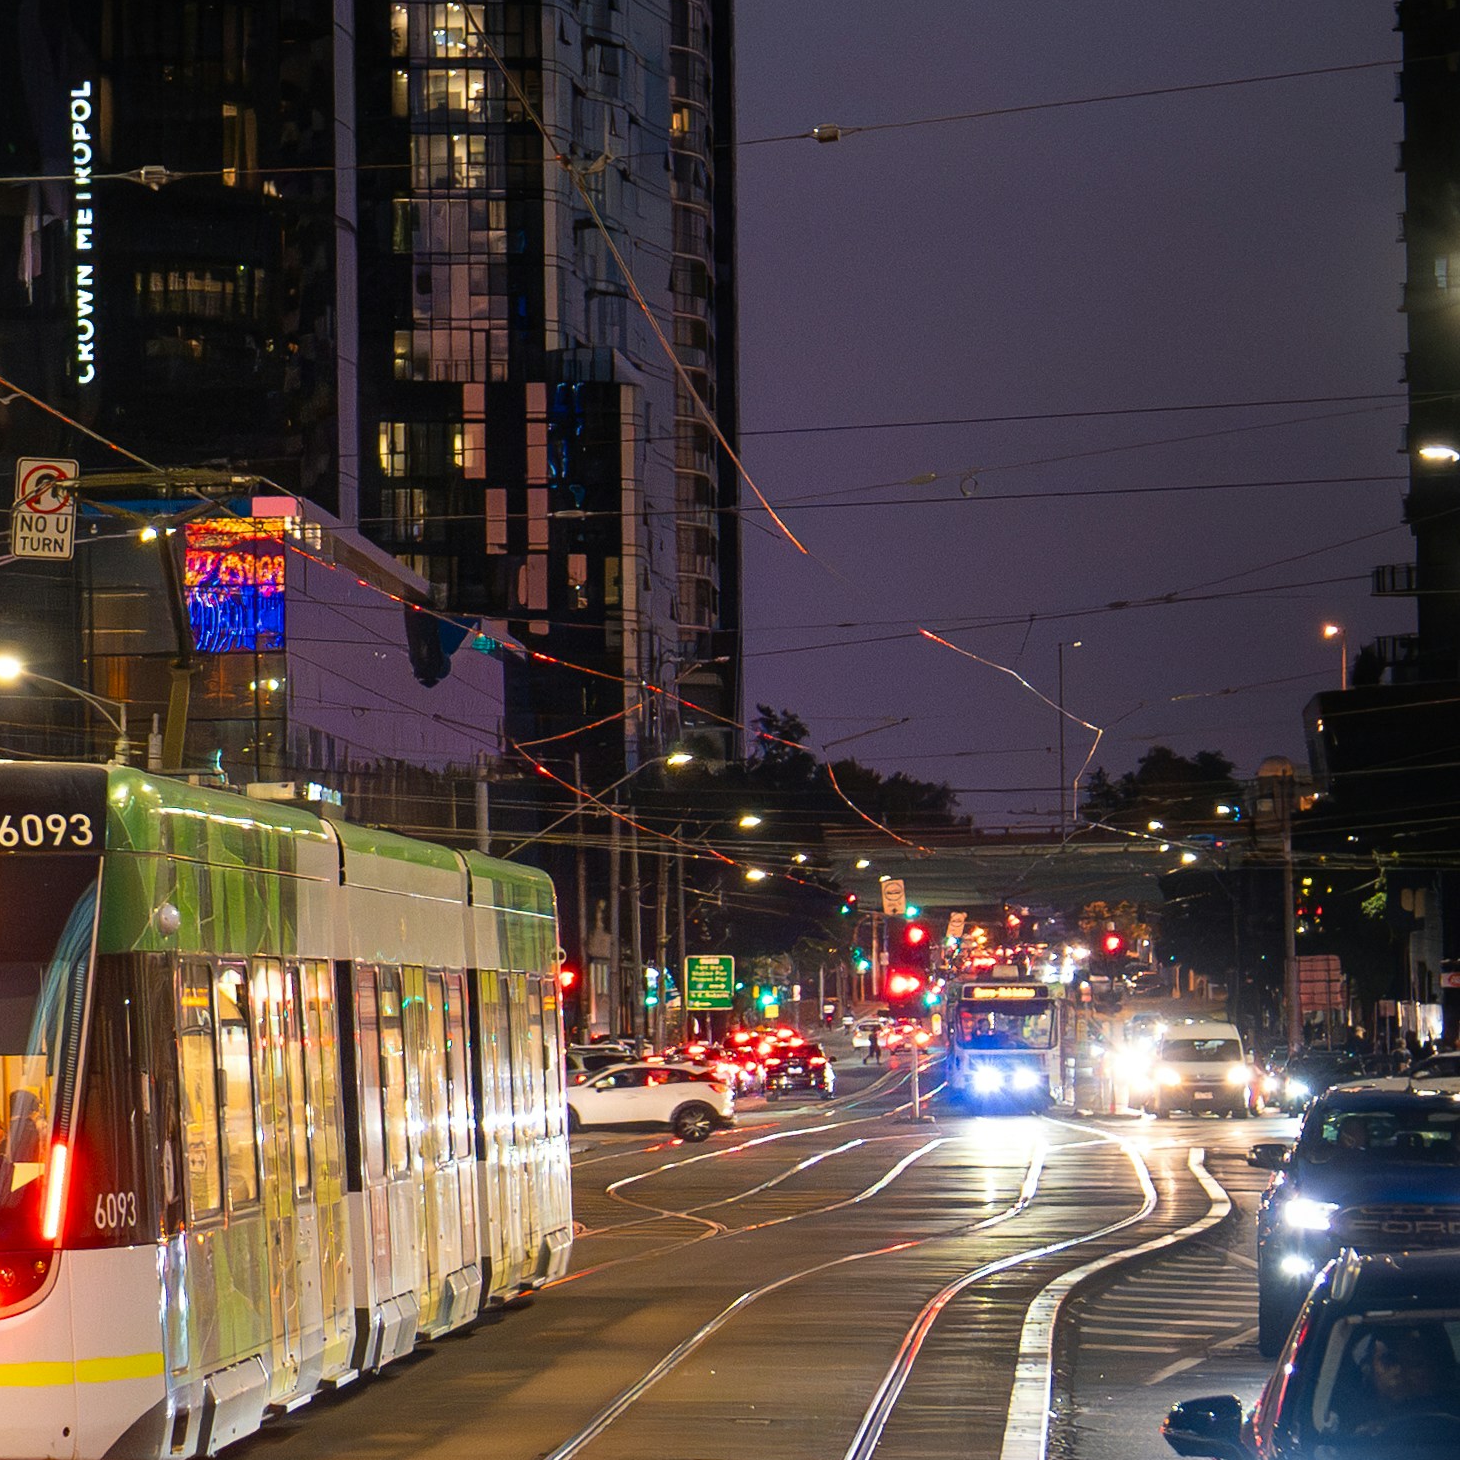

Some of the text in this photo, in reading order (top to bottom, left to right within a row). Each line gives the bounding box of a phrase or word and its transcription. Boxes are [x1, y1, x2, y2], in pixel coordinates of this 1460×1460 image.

[76, 264, 96, 385] CROWN
[20, 515, 68, 534] NO U
[20, 536, 64, 553] TURN
[94, 1191, 137, 1230] 6093
